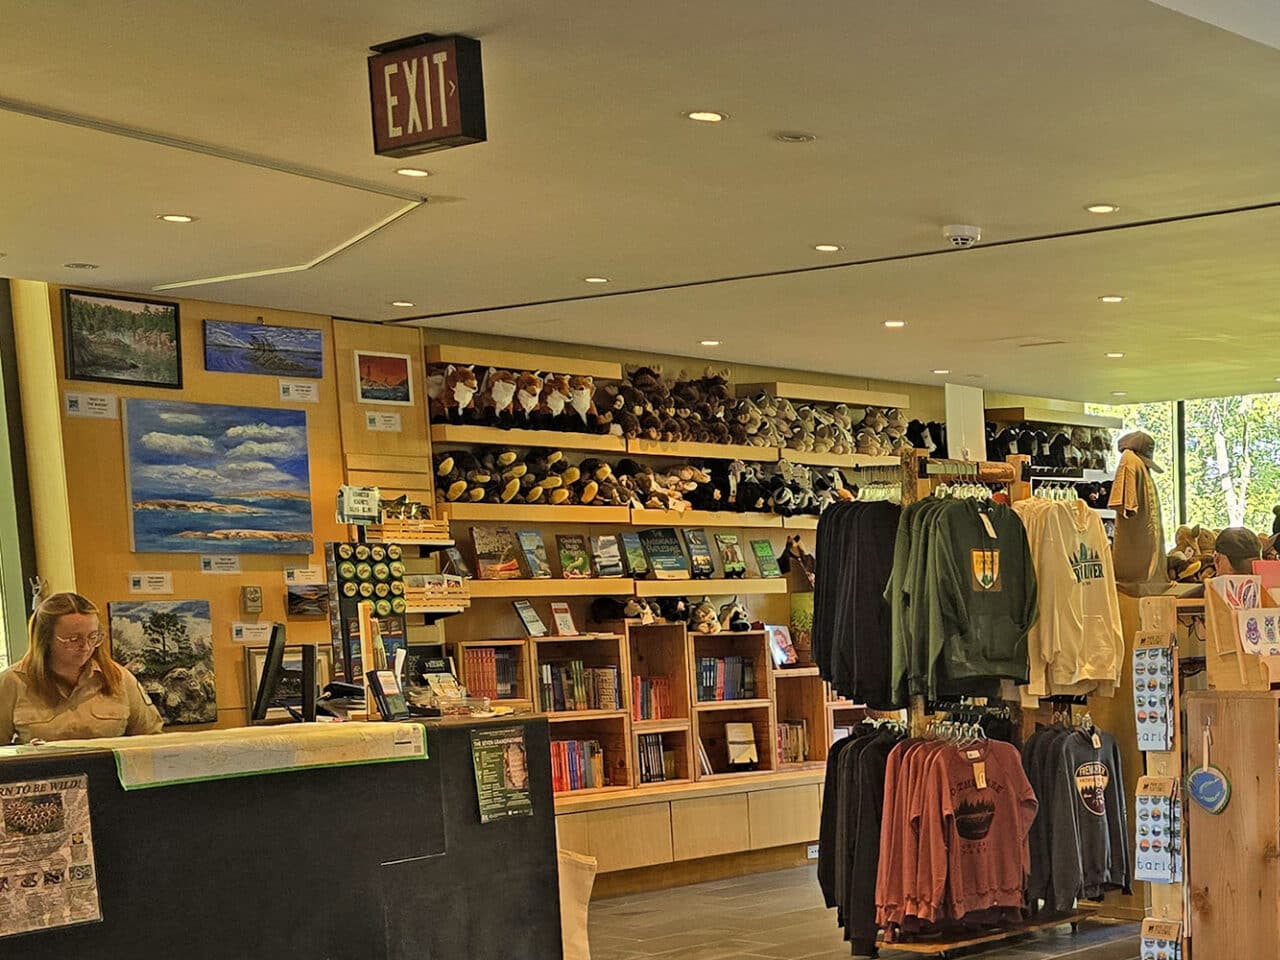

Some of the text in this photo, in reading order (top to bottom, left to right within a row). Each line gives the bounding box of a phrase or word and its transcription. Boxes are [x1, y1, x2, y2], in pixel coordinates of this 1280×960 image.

[384, 52, 447, 138] EXIT
[15, 785, 31, 794] TO
[33, 783, 47, 792] BE
[50, 779, 82, 790] WILD!
